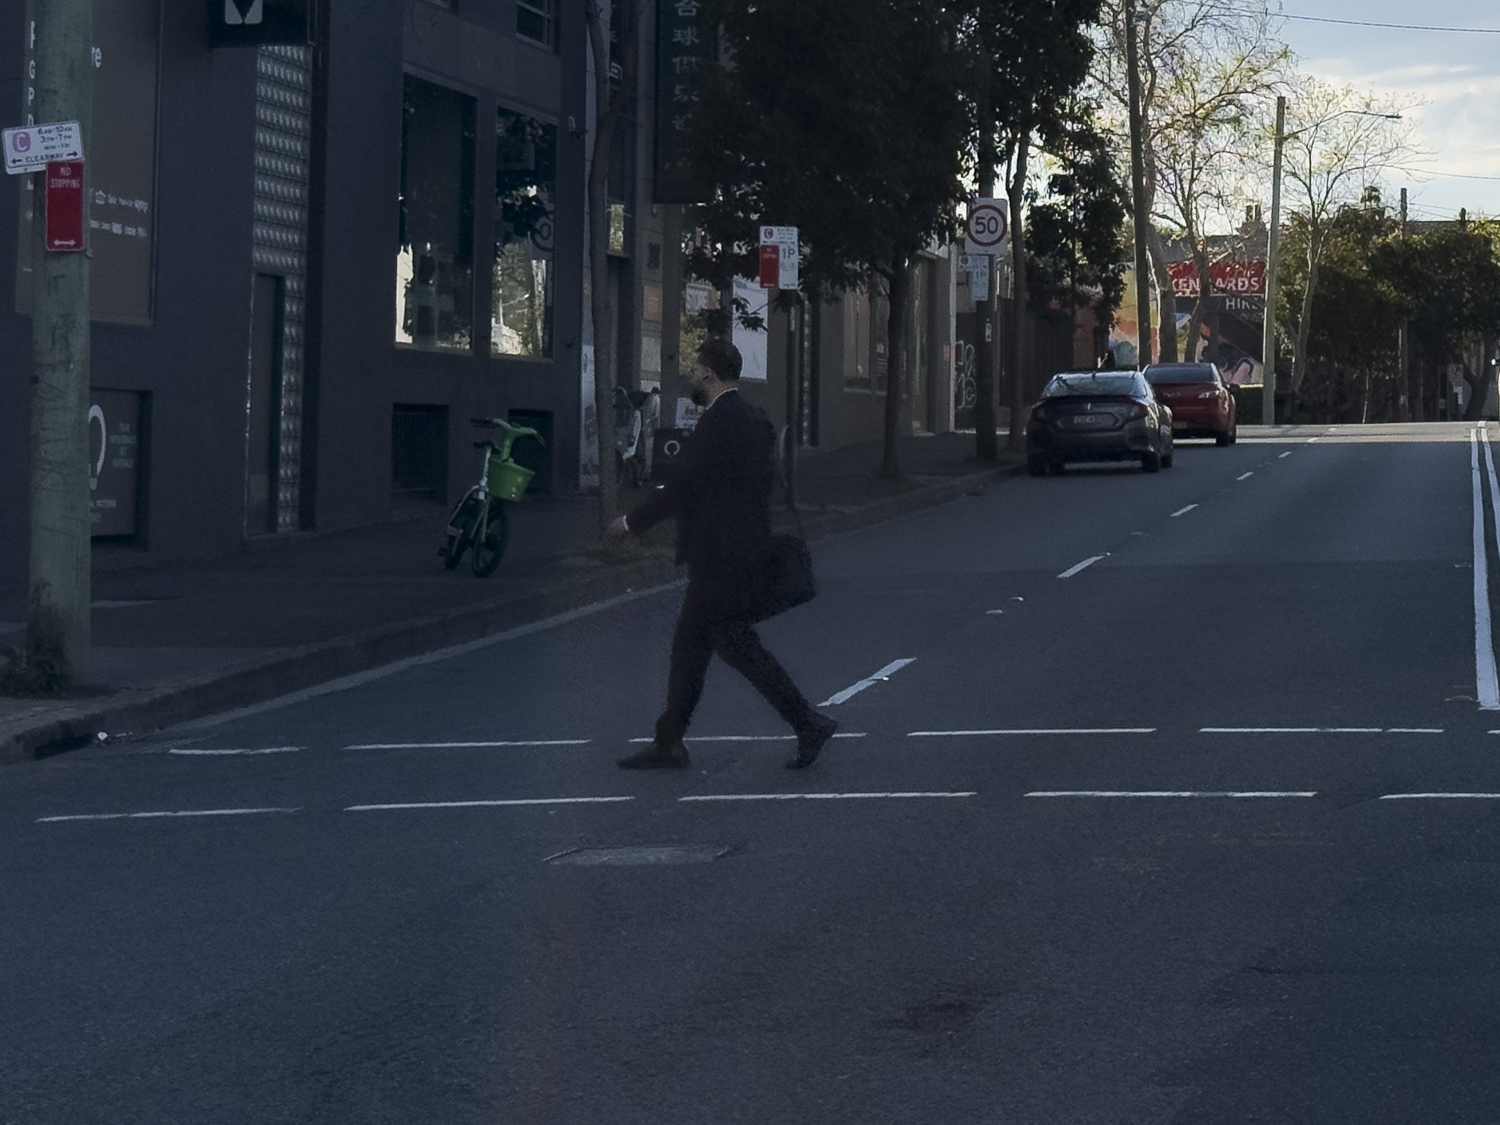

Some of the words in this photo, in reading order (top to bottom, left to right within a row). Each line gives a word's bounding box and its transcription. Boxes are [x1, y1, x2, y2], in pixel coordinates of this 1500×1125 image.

[25, 153, 64, 164] CLEARWAY
[60, 167, 72, 176] NO
[50, 179, 80, 188] STOPPING
[975, 216, 998, 234] 50
